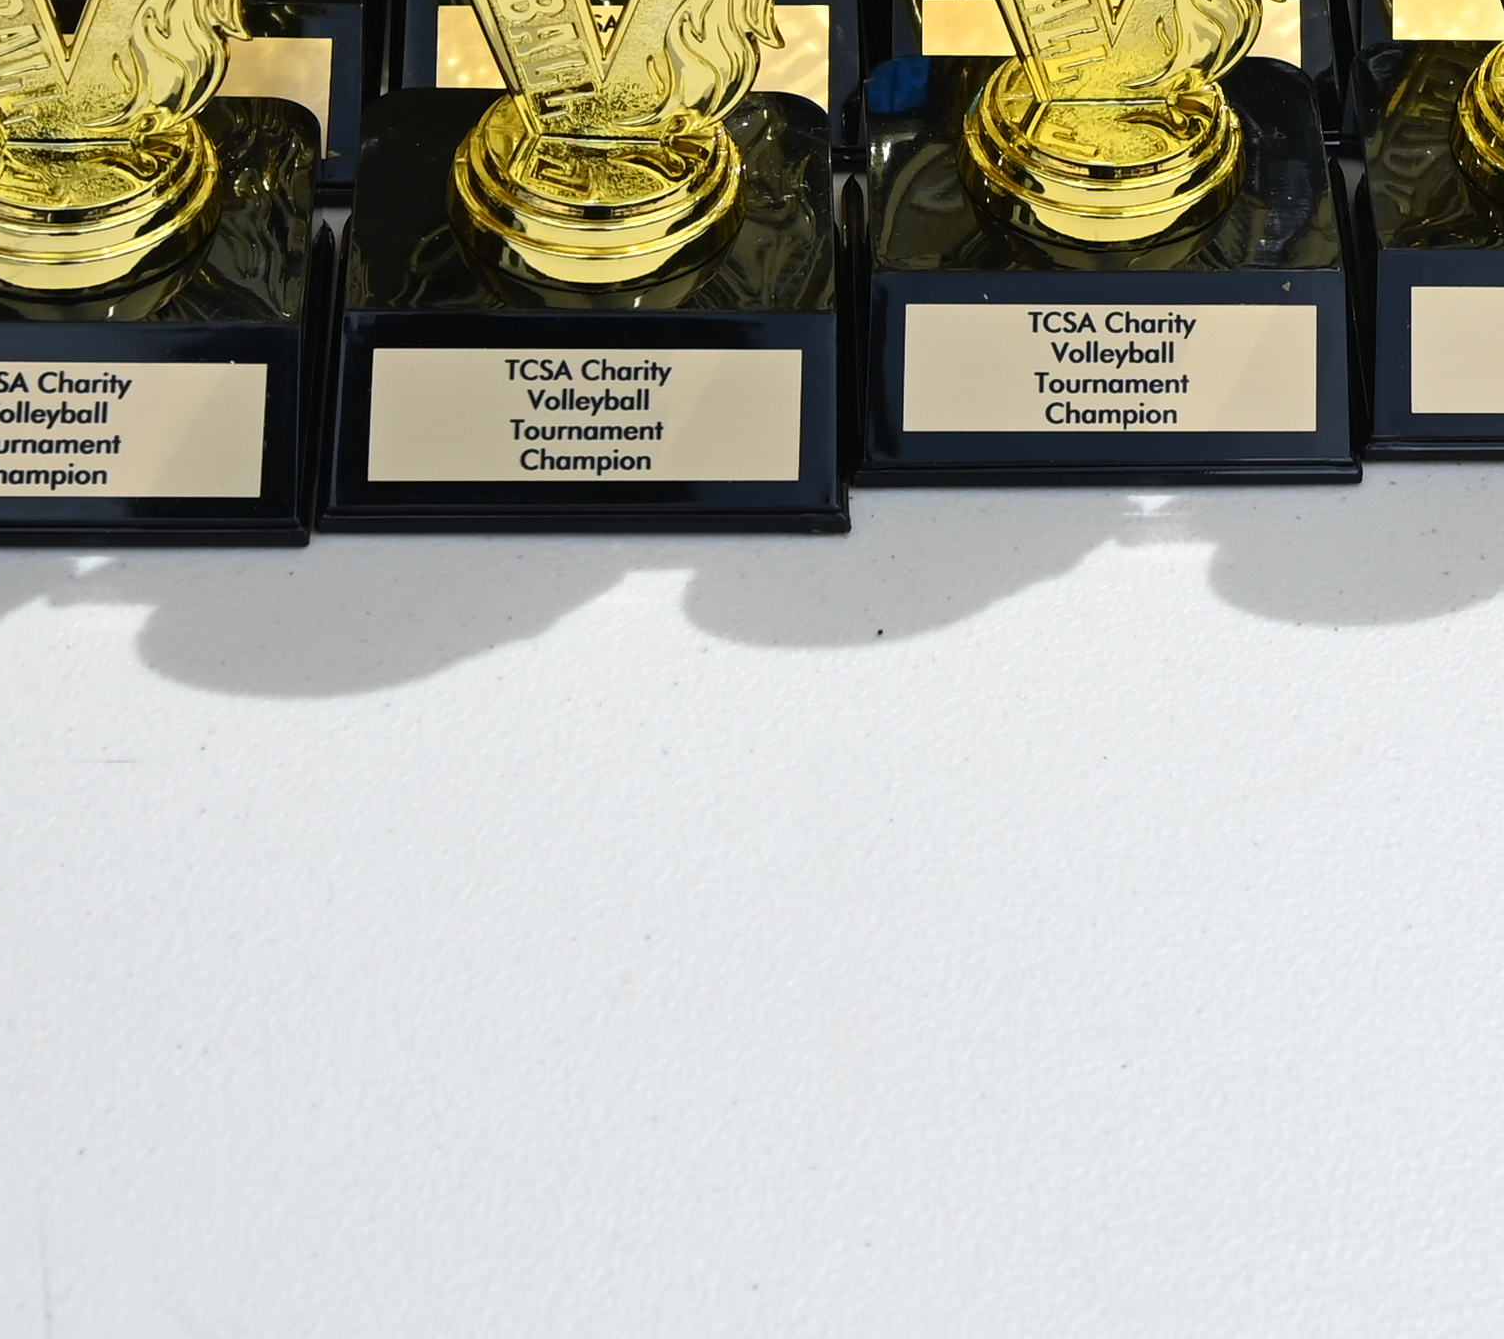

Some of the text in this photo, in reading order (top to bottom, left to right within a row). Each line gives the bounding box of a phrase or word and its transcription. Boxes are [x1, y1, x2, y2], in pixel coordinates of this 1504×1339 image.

[1027, 310, 1197, 340] TCSA Charity
[1050, 340, 1174, 370] Volleyball
[37, 369, 133, 400] Charity
[504, 358, 673, 387] TCSA Charity
[1033, 371, 1190, 394] Tournament
[526, 387, 650, 417] Volleyball
[1044, 401, 1178, 431] Champion
[509, 418, 664, 441] Tournament
[519, 447, 652, 477] Champion
